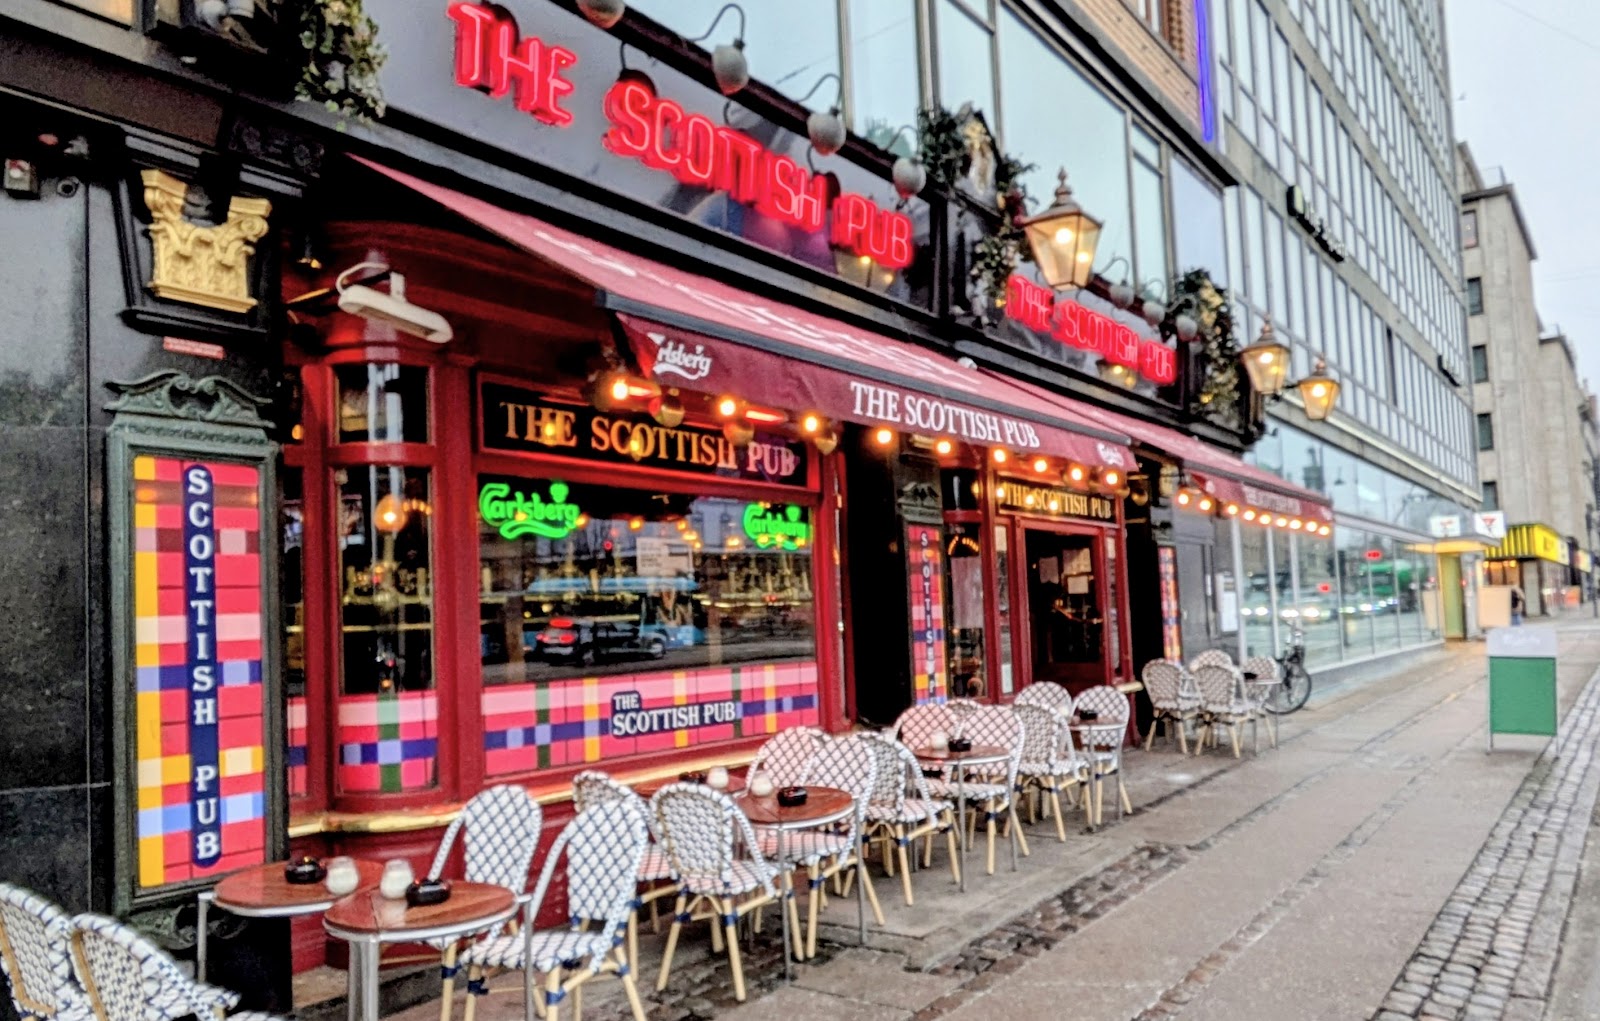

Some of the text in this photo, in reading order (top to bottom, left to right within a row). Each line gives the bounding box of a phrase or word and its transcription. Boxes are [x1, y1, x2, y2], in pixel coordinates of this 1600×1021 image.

[446, 0, 914, 270] THE SCOTTISH PUB
[1006, 275, 1176, 384] THE SCOTTISH PUB
[501, 402, 800, 476] THE SCOTTISH PUB
[851, 381, 1040, 448] THE SCOTTISH PUB
[479, 483, 580, 535] Carlsberg
[1005, 483, 1112, 519] THE SCOTTISH PUB
[188, 469, 221, 859] SCOTTISH PUB
[613, 694, 639, 710] THE
[613, 701, 736, 736] SCOTTISH PUB
